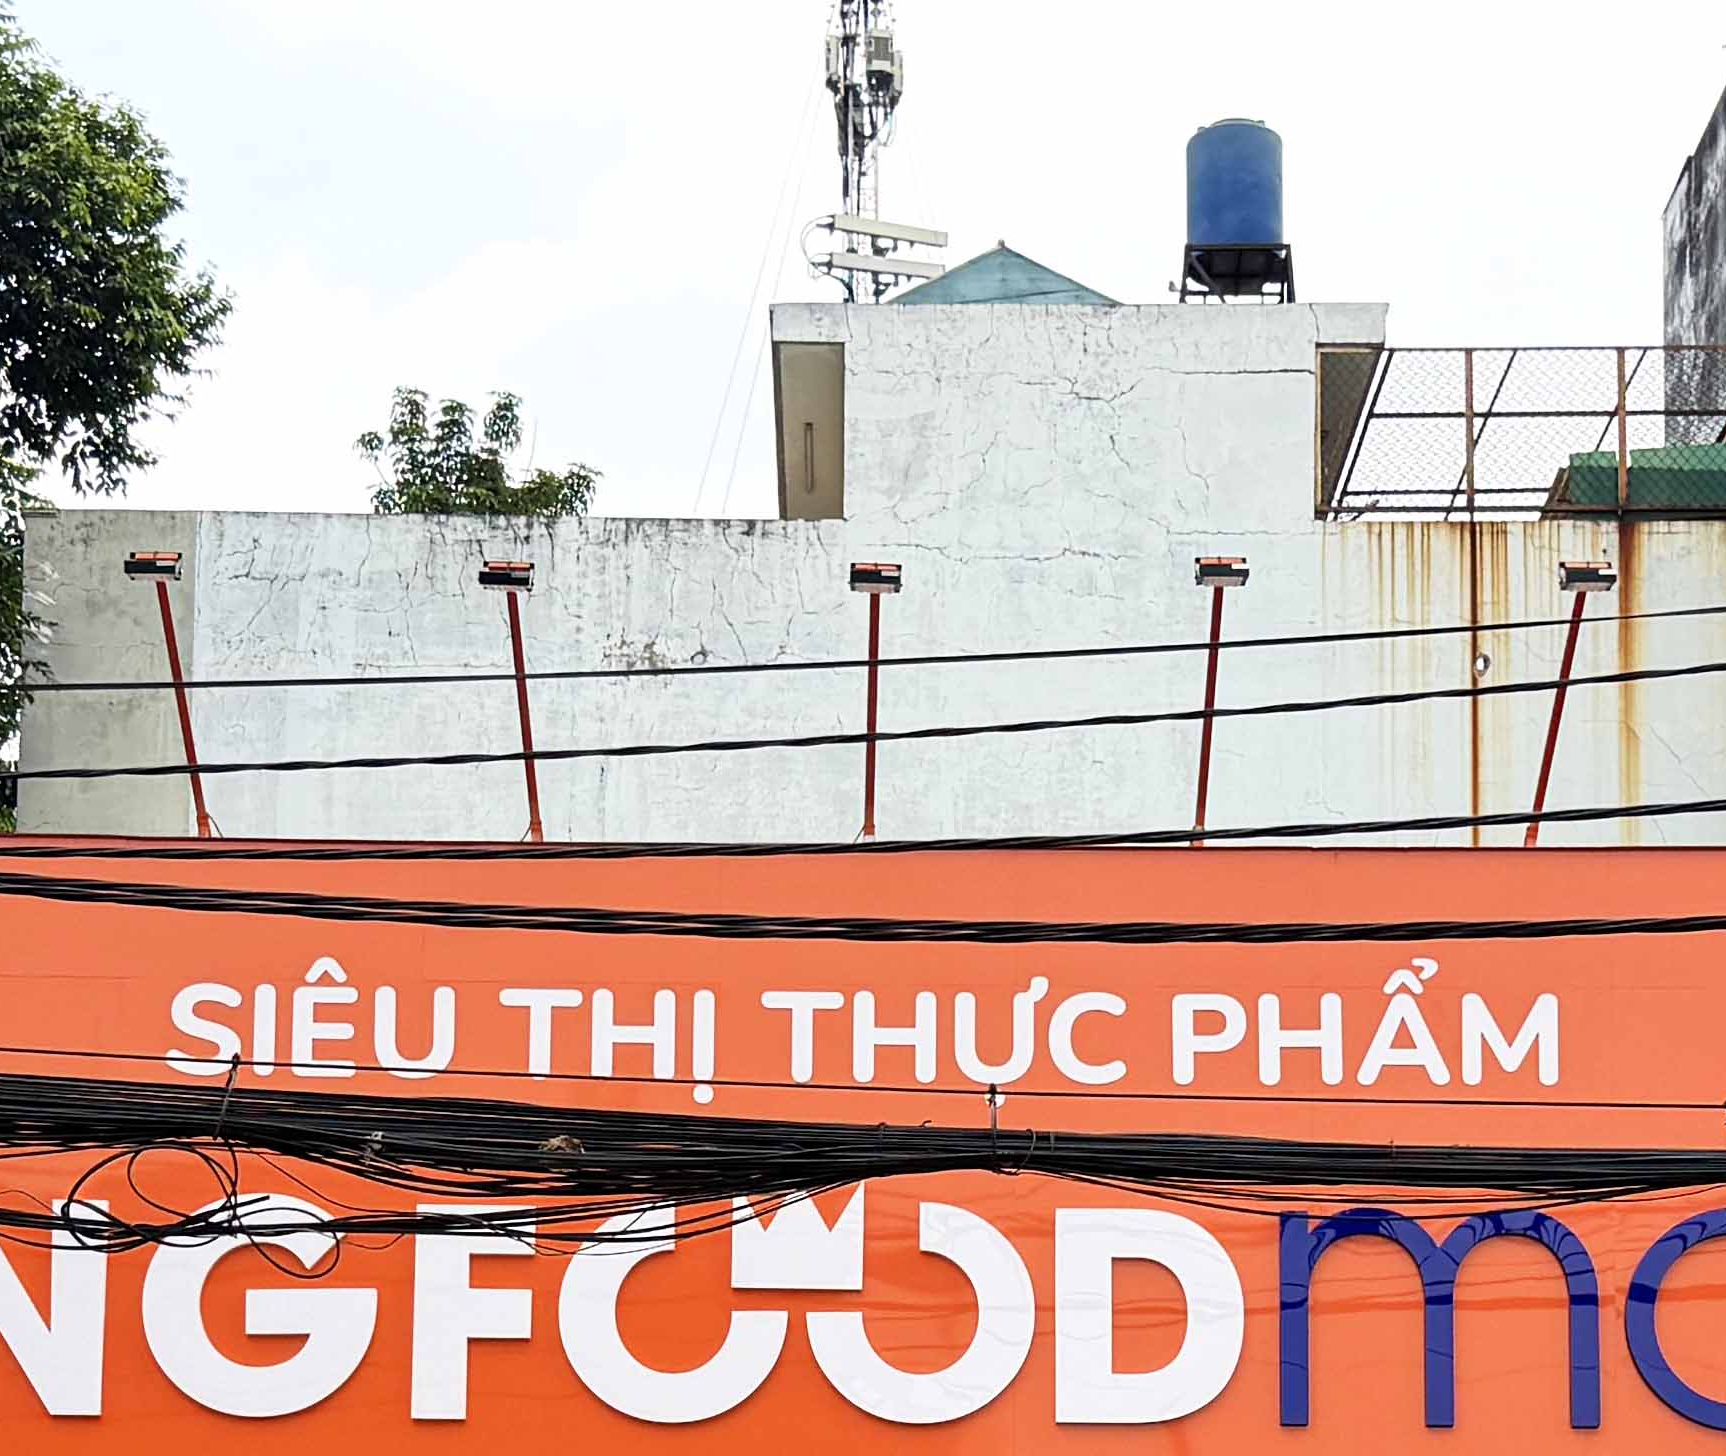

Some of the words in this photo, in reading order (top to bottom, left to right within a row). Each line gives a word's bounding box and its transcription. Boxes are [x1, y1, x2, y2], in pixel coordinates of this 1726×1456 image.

[165, 955, 457, 1080] SIÊU
[499, 987, 716, 1105] THỊ
[761, 975, 1128, 1108] THỰC
[1171, 958, 1560, 1088] PHẨM
